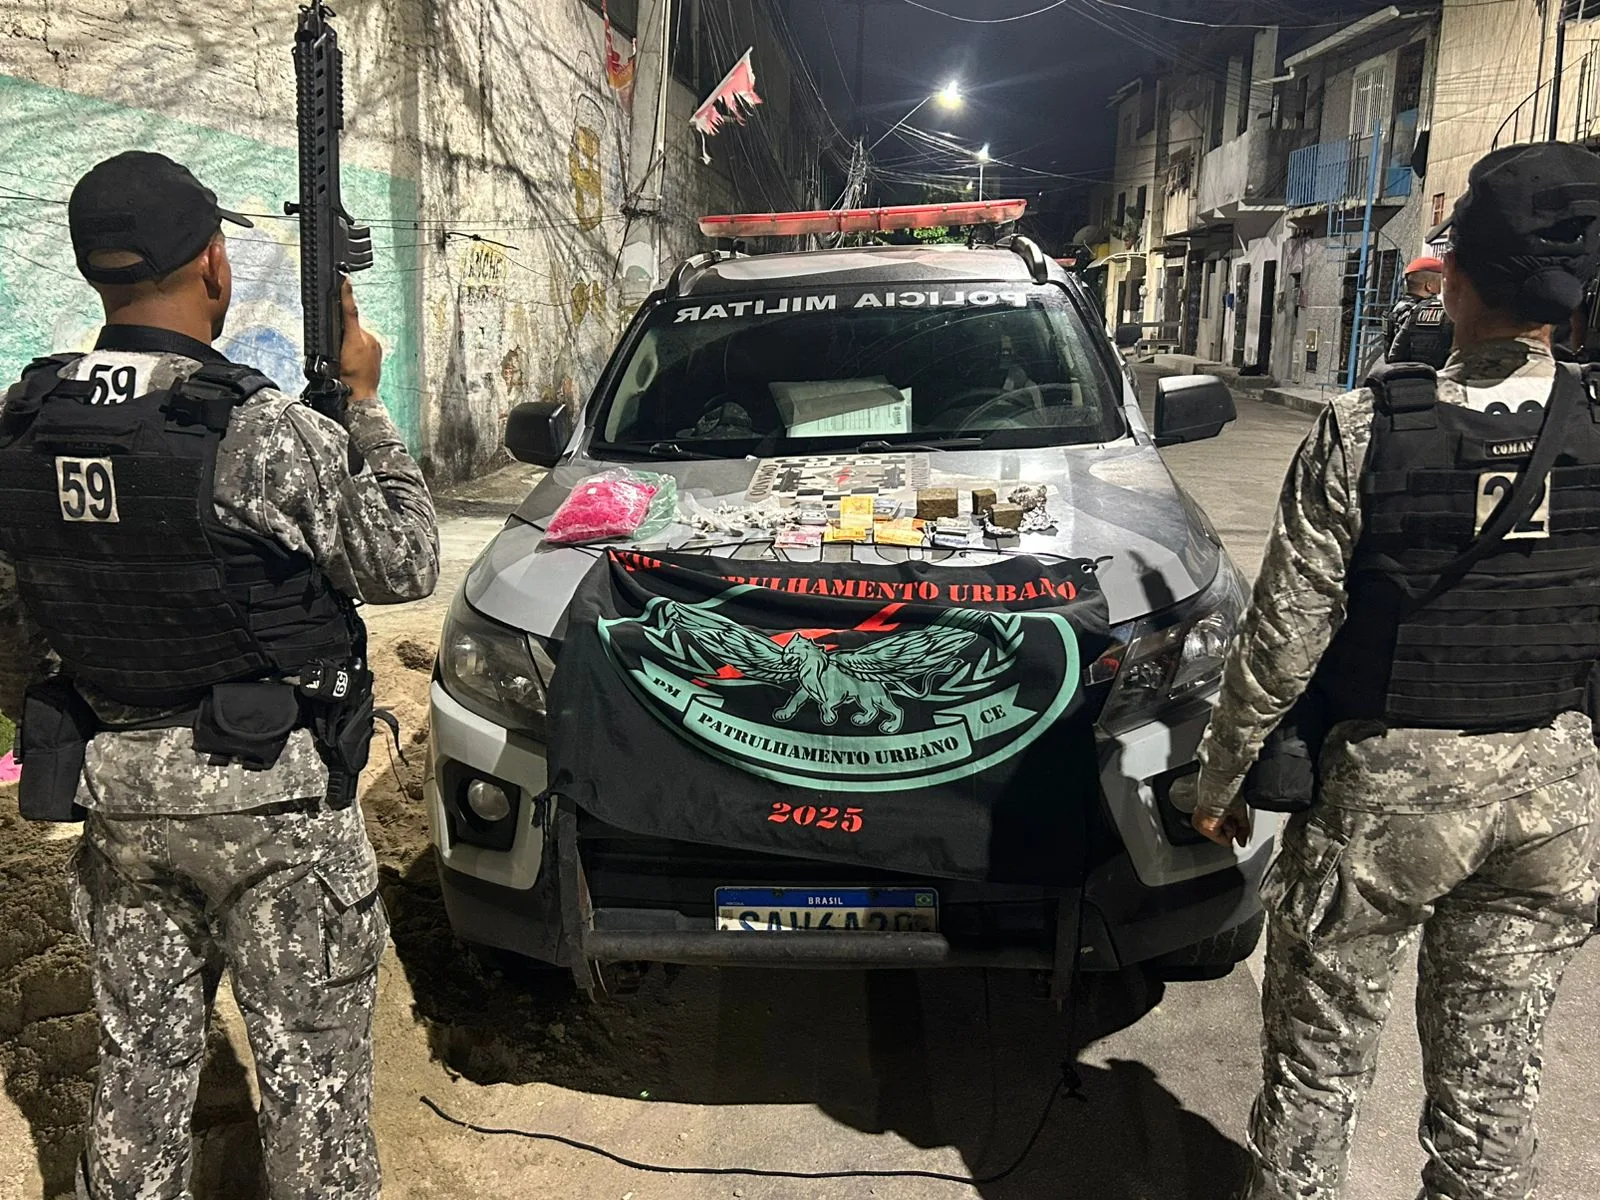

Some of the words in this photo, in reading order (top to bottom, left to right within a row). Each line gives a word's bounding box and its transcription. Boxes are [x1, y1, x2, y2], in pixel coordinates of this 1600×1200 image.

[89, 364, 136, 404] 59
[1492, 441, 1535, 455] COMAN
[62, 461, 113, 520] 59
[949, 577, 1077, 602] URBANO
[335, 673, 348, 695] 59
[653, 677, 682, 698] PM
[980, 704, 1007, 724] CE
[697, 712, 870, 765] PATRULHAMENTO
[876, 736, 959, 764] URBANO
[767, 802, 864, 832] 2025
[808, 896, 844, 905] BRASIL
